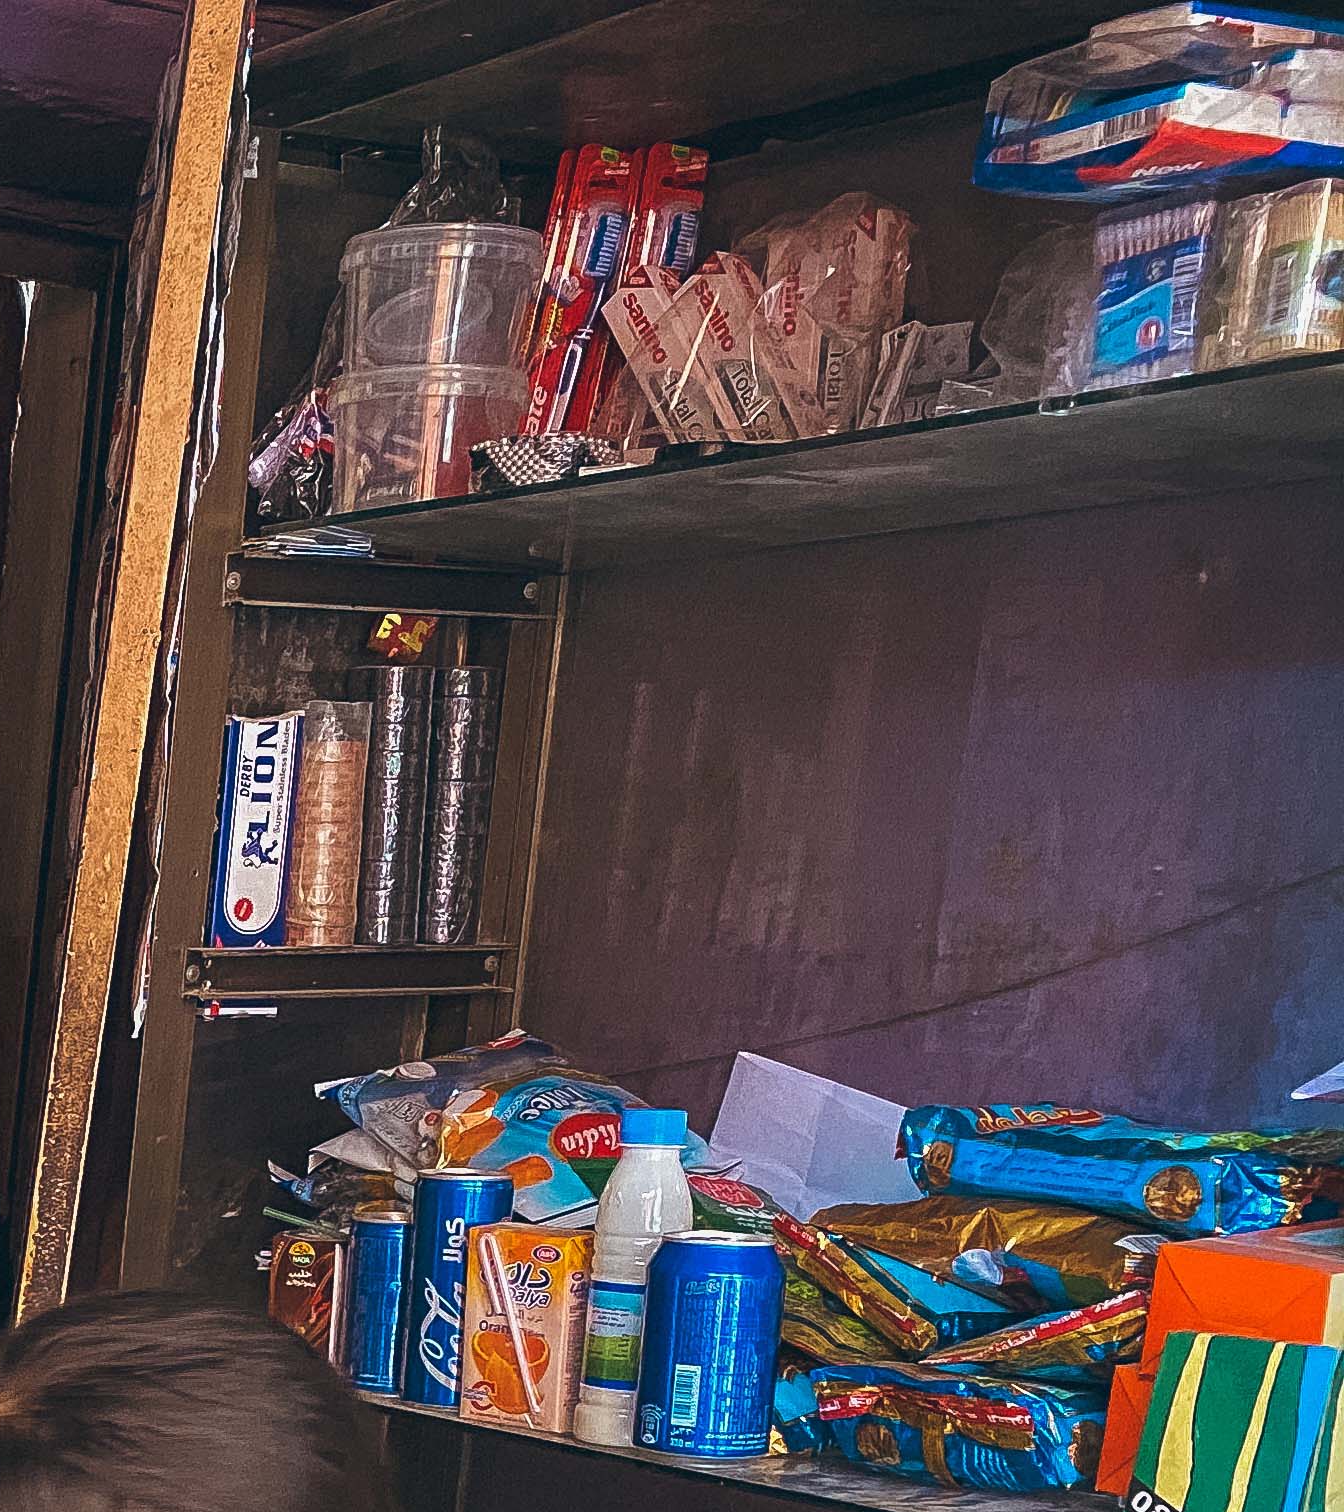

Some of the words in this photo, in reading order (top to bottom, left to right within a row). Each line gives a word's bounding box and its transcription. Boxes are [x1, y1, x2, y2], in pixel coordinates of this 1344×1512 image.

[623, 292, 668, 364] sanino
[282, 720, 292, 755] Blades
[239, 756, 255, 798] DERBY
[248, 720, 280, 833] LION
[277, 756, 289, 807] Stainless
[272, 807, 283, 834] Super
